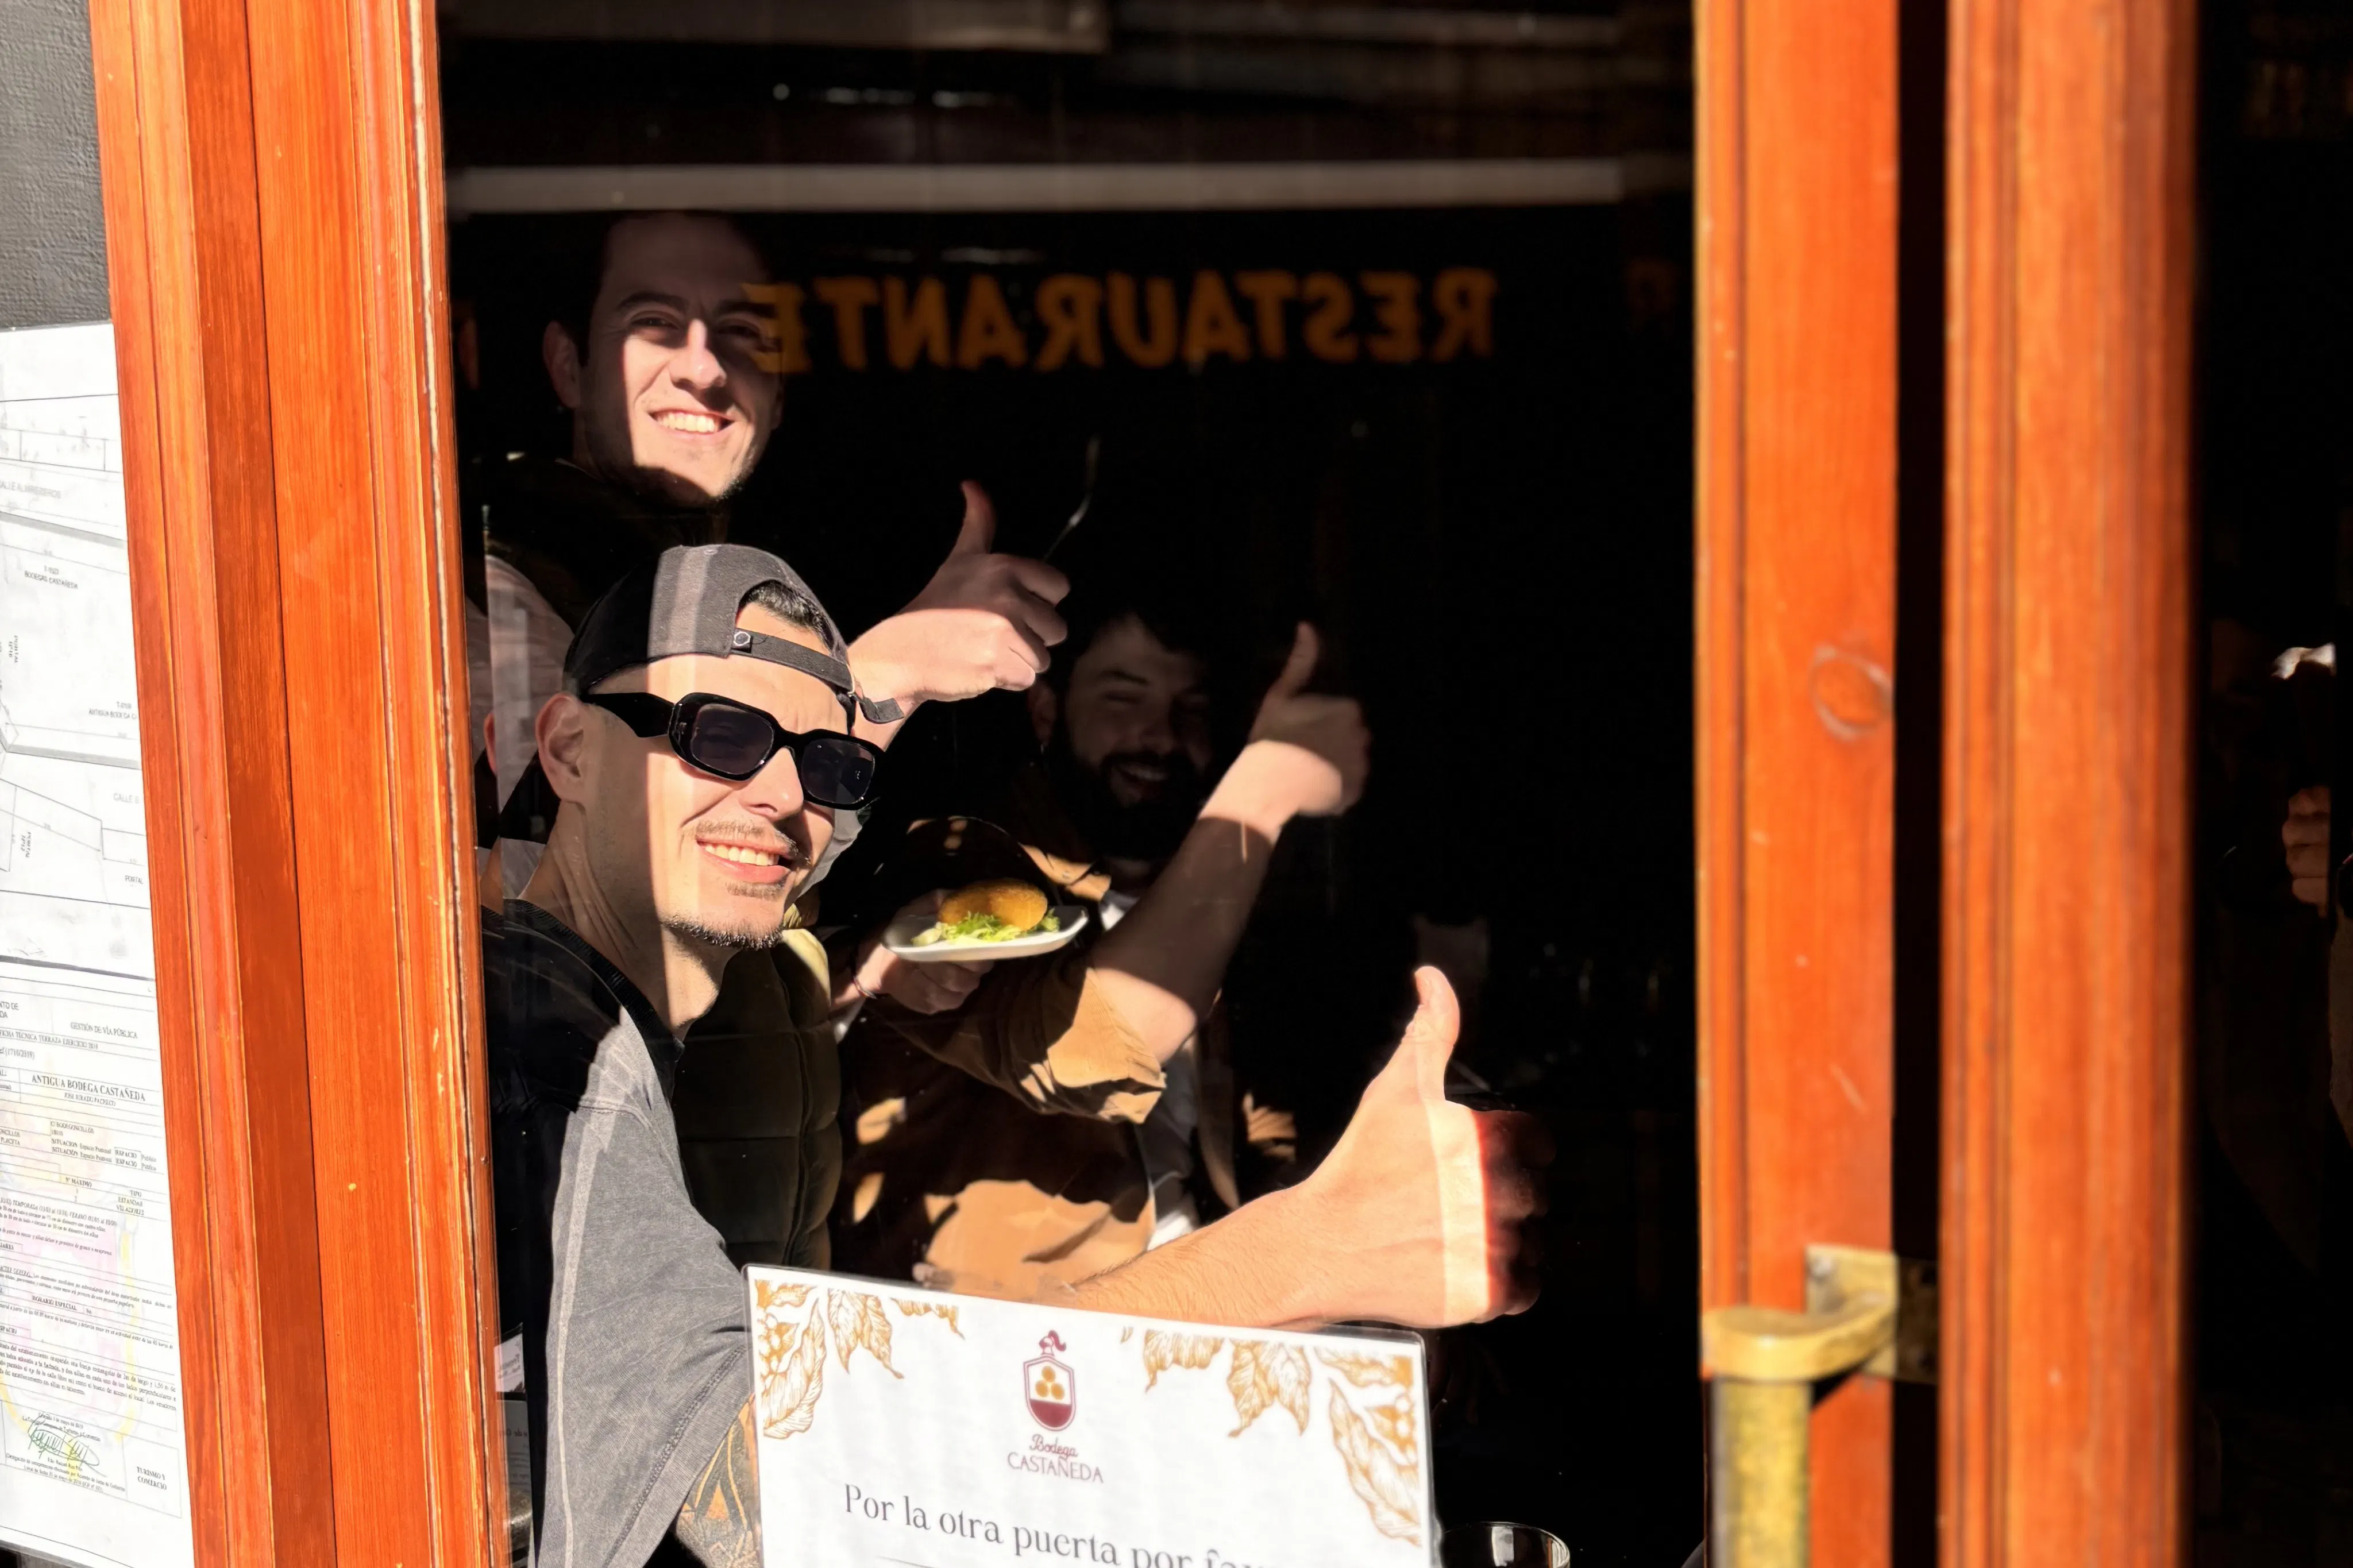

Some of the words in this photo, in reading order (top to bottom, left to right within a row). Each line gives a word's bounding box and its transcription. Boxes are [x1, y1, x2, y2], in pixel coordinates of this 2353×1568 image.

[32, 1075, 65, 1088] ANTIGUA
[67, 1080, 98, 1094] BODEGA
[100, 1085, 146, 1102] CASTAÑEDA
[1029, 1434, 1078, 1461] Bodega
[1008, 1451, 1104, 1484] CASTAÑEDA
[845, 1484, 894, 1521] Por
[904, 1496, 931, 1530] la
[939, 1509, 1004, 1544] otra
[1013, 1525, 1121, 1566] puerta
[1131, 1547, 1192, 1568] por
